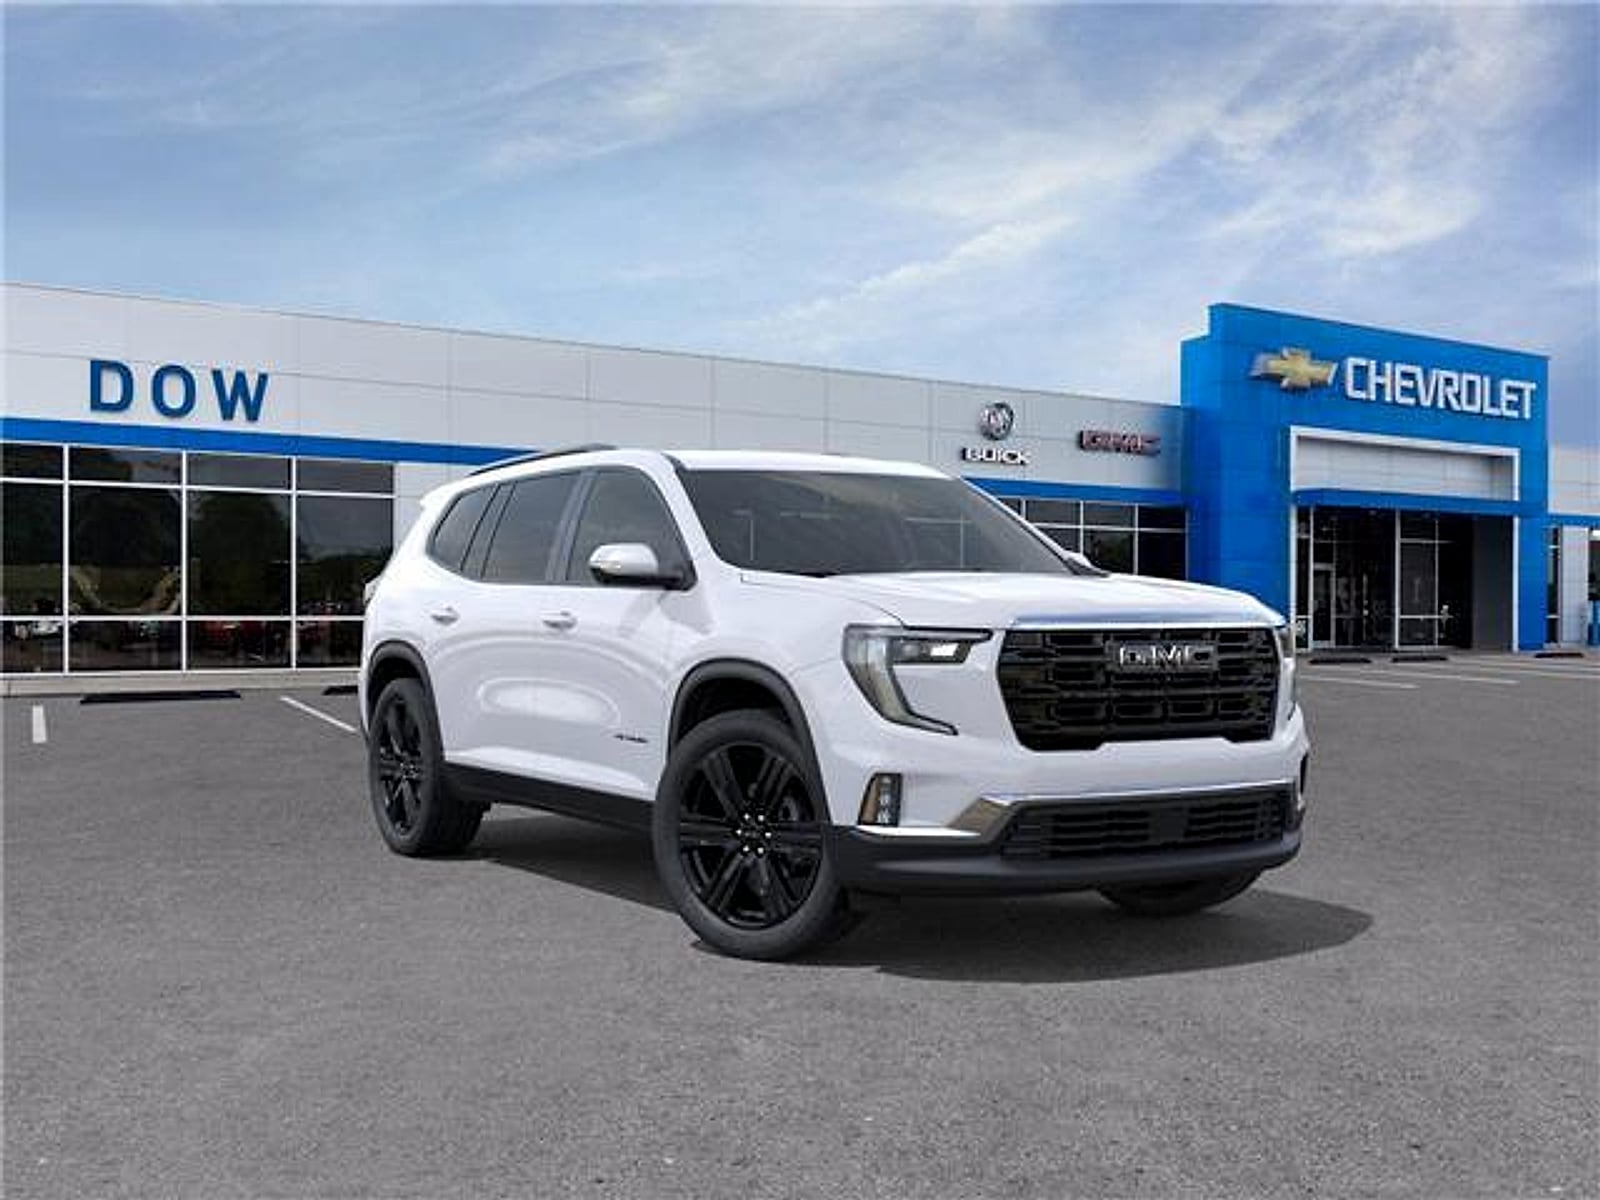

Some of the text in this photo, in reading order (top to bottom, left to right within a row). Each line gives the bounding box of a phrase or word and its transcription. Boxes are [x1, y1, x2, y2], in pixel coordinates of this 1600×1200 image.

[90, 359, 269, 422] DOW
[1344, 356, 1538, 420] CHEVROLET
[961, 447, 1031, 465] BUICK
[1078, 429, 1161, 457] GMC
[1118, 643, 1214, 673] GMC
